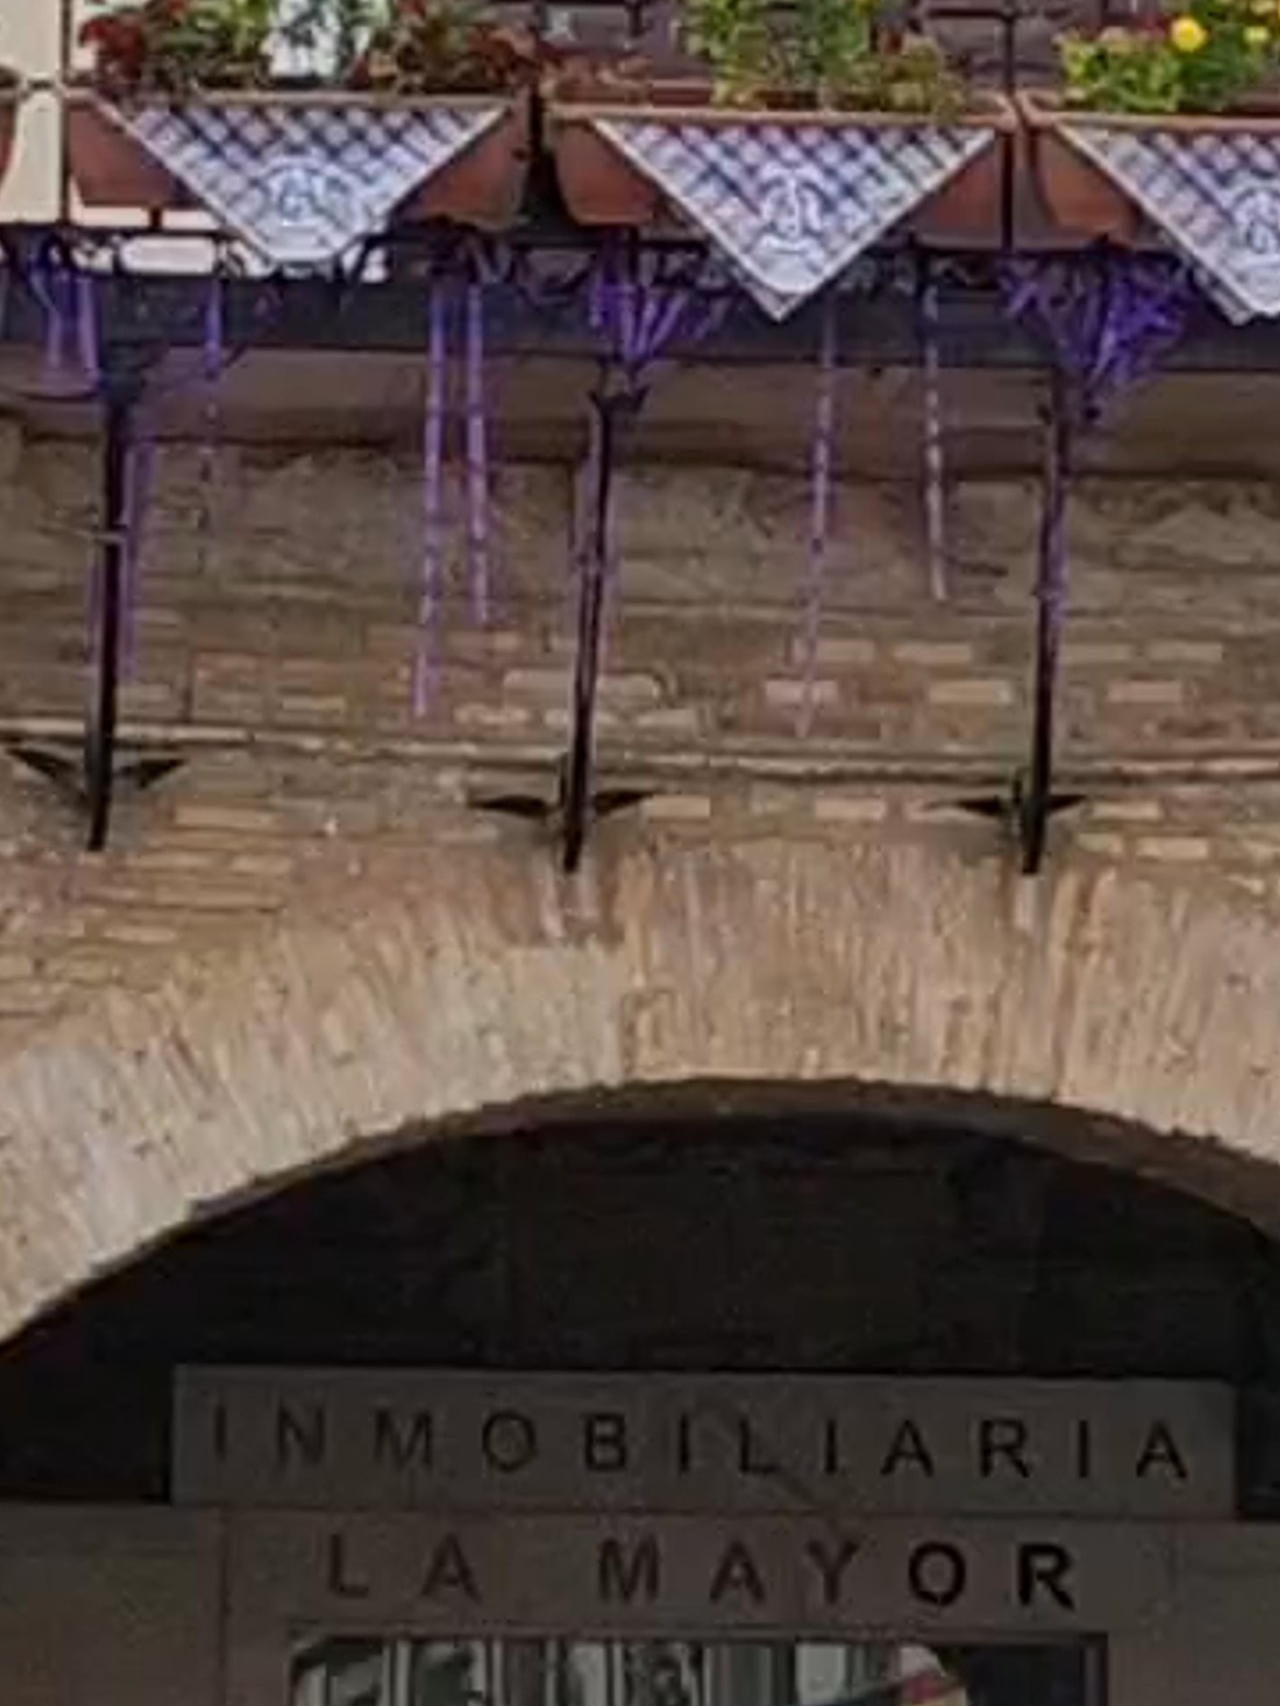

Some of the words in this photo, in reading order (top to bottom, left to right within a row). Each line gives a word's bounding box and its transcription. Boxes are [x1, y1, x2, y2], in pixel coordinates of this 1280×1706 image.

[213, 1404, 1190, 1481] INMOBILIARIA
[325, 1533, 481, 1602] LA
[597, 1535, 1077, 1609] MAYOR
